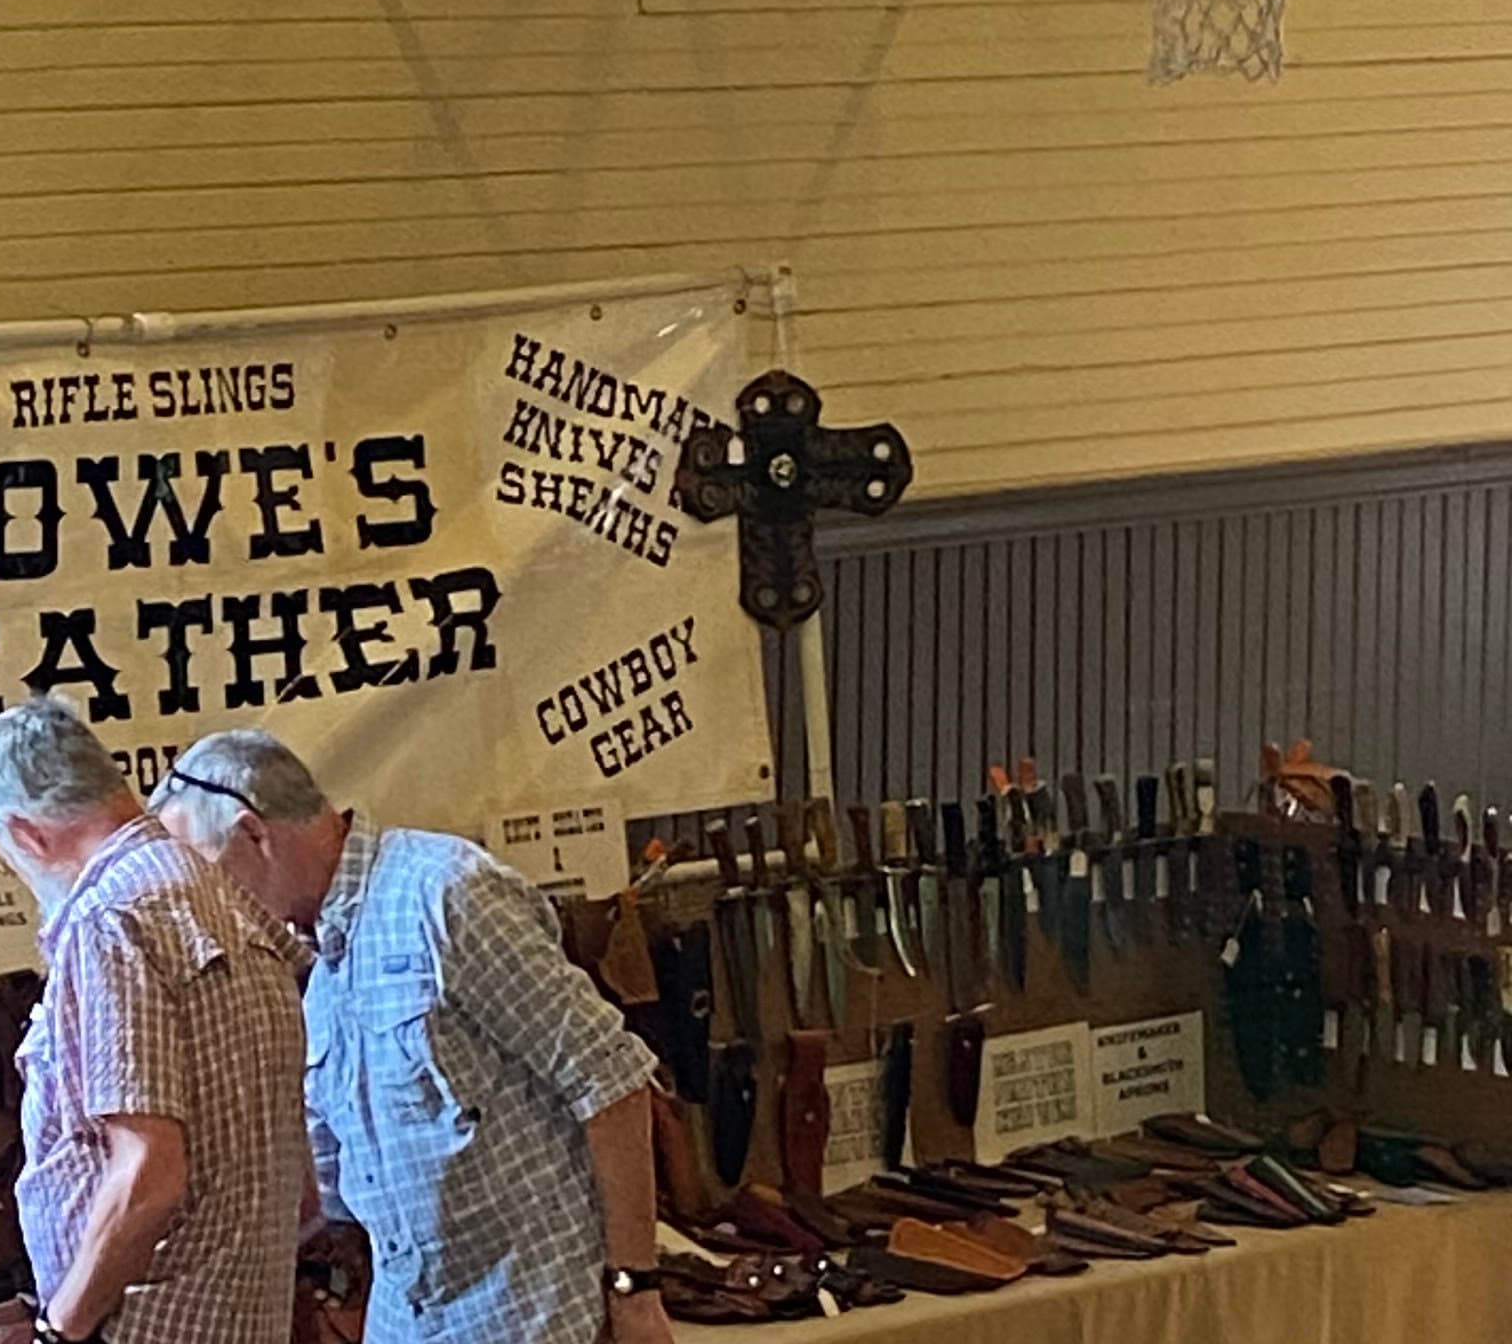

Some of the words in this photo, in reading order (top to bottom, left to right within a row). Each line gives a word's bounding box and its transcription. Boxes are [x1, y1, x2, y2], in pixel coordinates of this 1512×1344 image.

[10, 373, 138, 428] RIFLE
[149, 363, 295, 418] SLINGS
[505, 333, 732, 444] HANDMA
[503, 399, 664, 494] KNIVES
[496, 461, 679, 568] SHEATHS
[536, 615, 699, 745] COWBOY
[590, 690, 694, 778] GEAR
